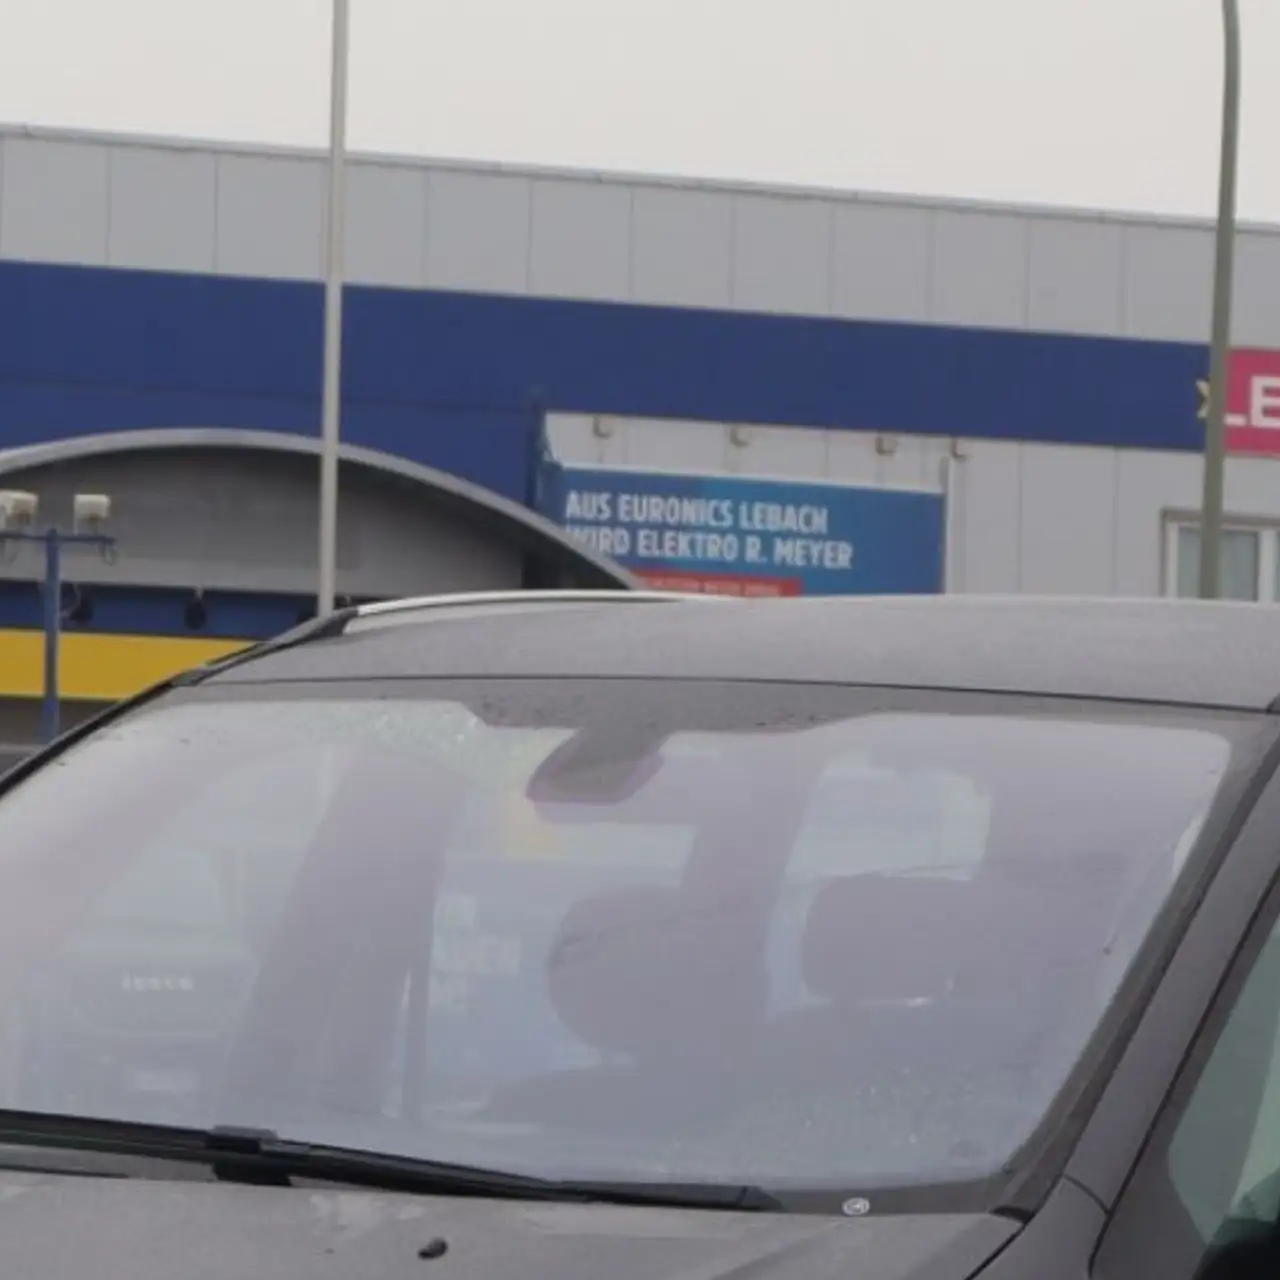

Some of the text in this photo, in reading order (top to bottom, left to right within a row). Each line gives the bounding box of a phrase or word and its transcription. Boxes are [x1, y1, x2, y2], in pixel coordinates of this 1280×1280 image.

[566, 490, 828, 535] AUS EURONICS LEBACH
[637, 528, 738, 562] ELEKTRO
[745, 534, 768, 564] R.
[773, 536, 853, 570] MEYER
